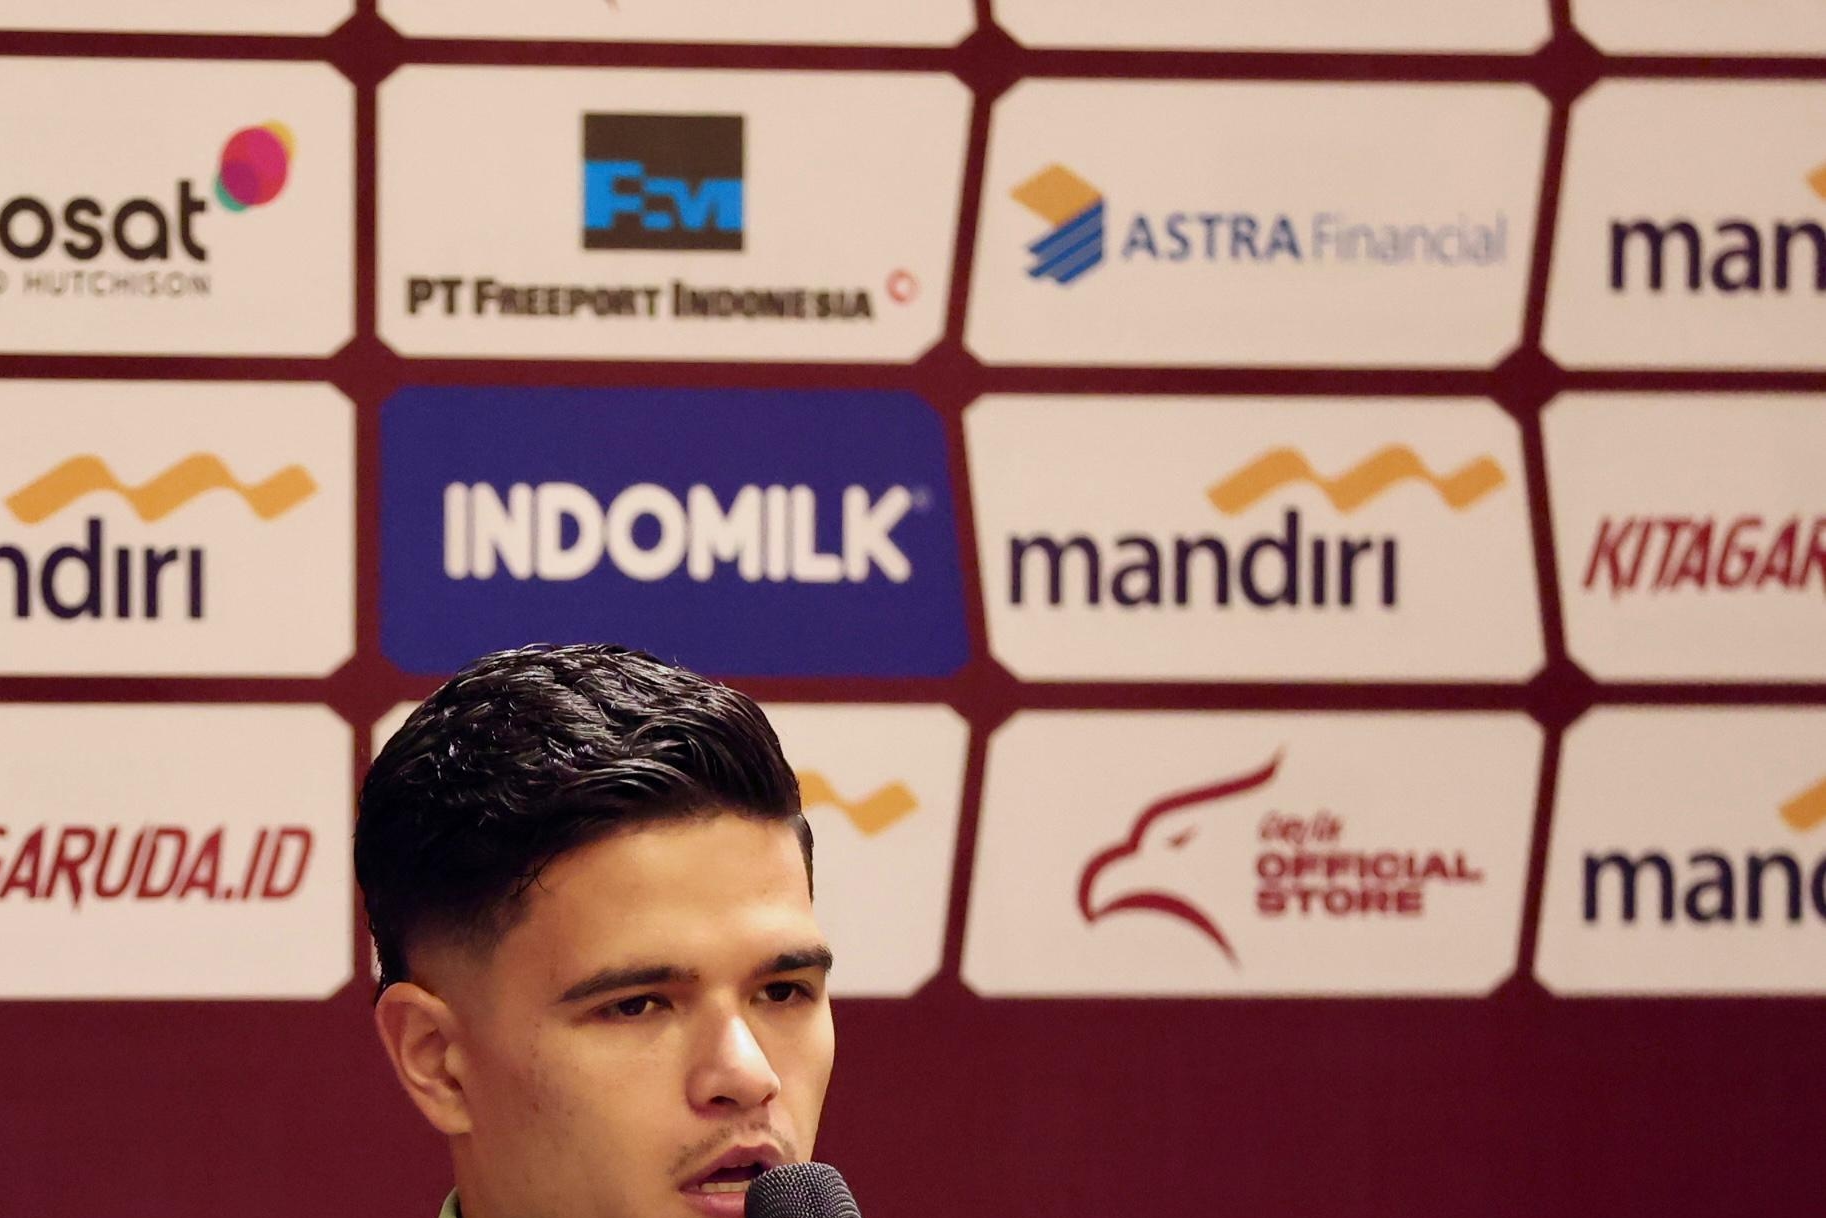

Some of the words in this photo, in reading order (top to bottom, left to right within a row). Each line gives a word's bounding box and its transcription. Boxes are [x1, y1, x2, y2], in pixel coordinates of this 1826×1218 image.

[1122, 212, 1302, 261] ASTRA
[1311, 210, 1508, 266] Financial
[23, 268, 211, 299] HUTCHISON
[407, 277, 464, 315] PT
[474, 278, 662, 318] FREEPORT
[671, 280, 872, 320] INDONESIA
[443, 481, 912, 583] INDOMILK
[1009, 509, 1397, 608] mandiri
[1256, 852, 1481, 881] OFFICIAL
[1583, 851, 1826, 924] man
[1256, 889, 1423, 915] STORE
